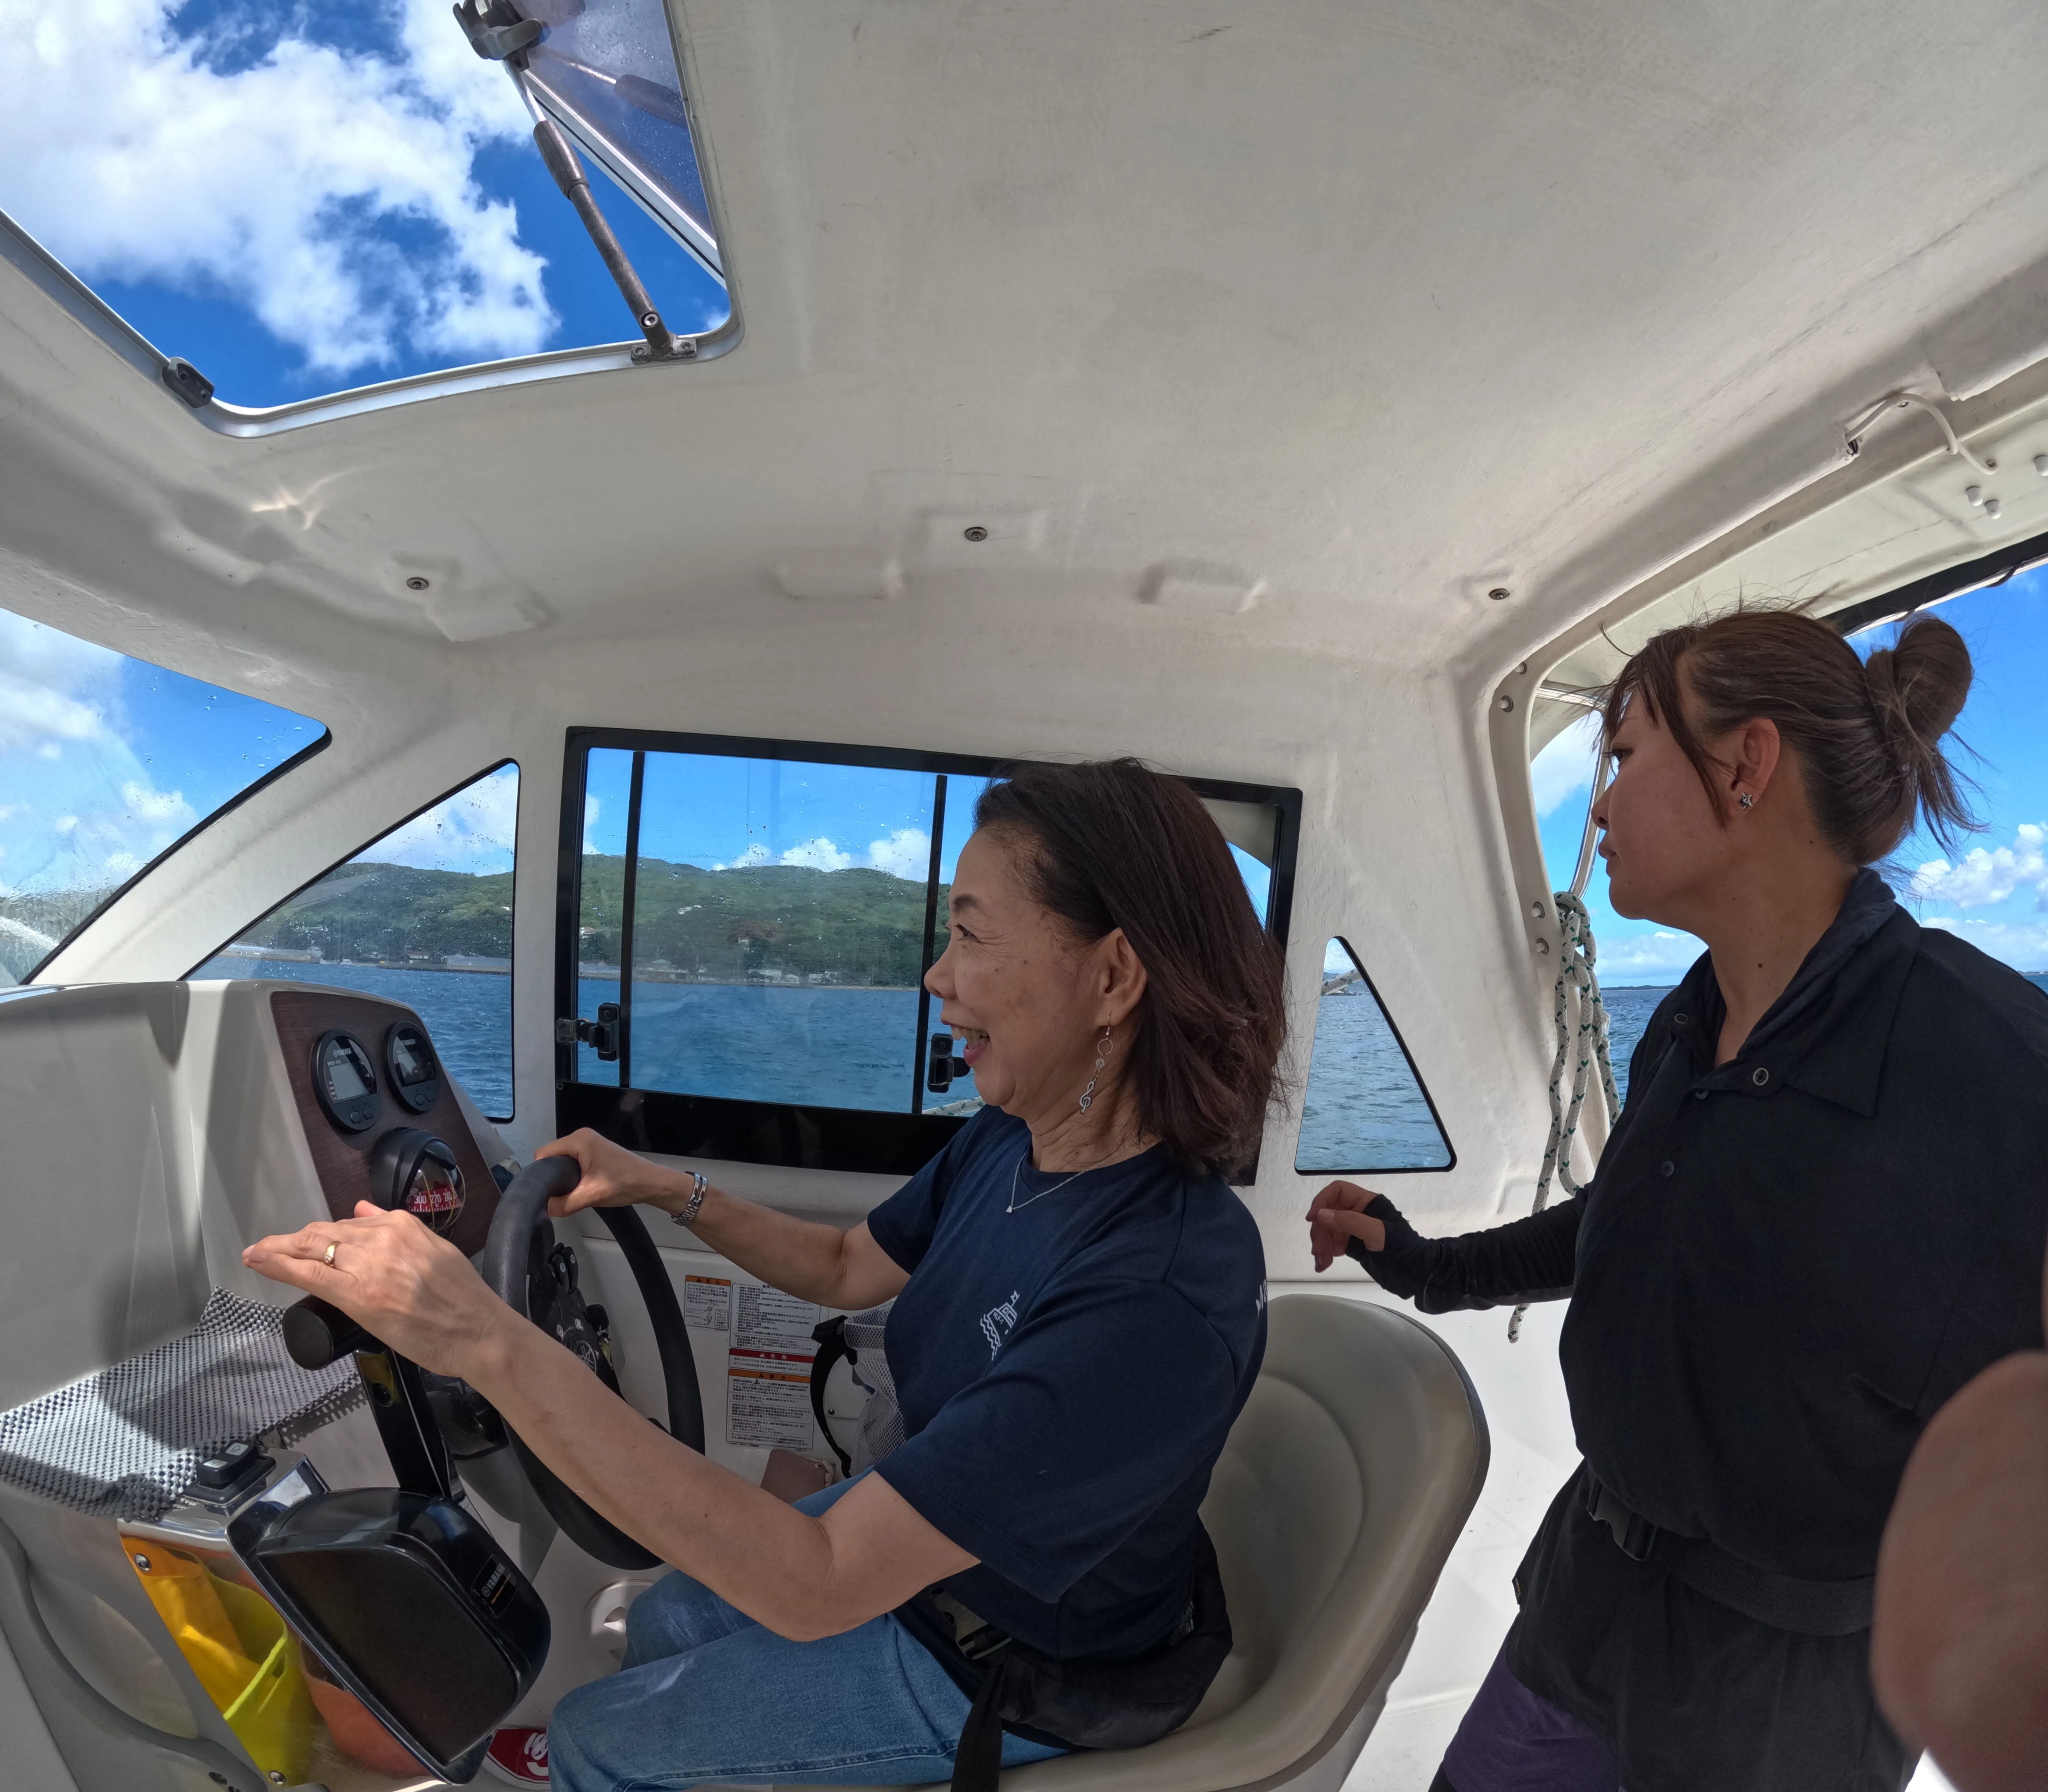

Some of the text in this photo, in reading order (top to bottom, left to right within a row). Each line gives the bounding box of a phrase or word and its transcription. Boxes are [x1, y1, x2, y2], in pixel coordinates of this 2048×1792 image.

[414, 1195, 427, 1204] 300
[431, 1194, 441, 1203] 270
[443, 1191, 452, 1202] 240
[993, 1311, 1003, 1325] MLF-1
[486, 1563, 506, 1590] YAMAHA
